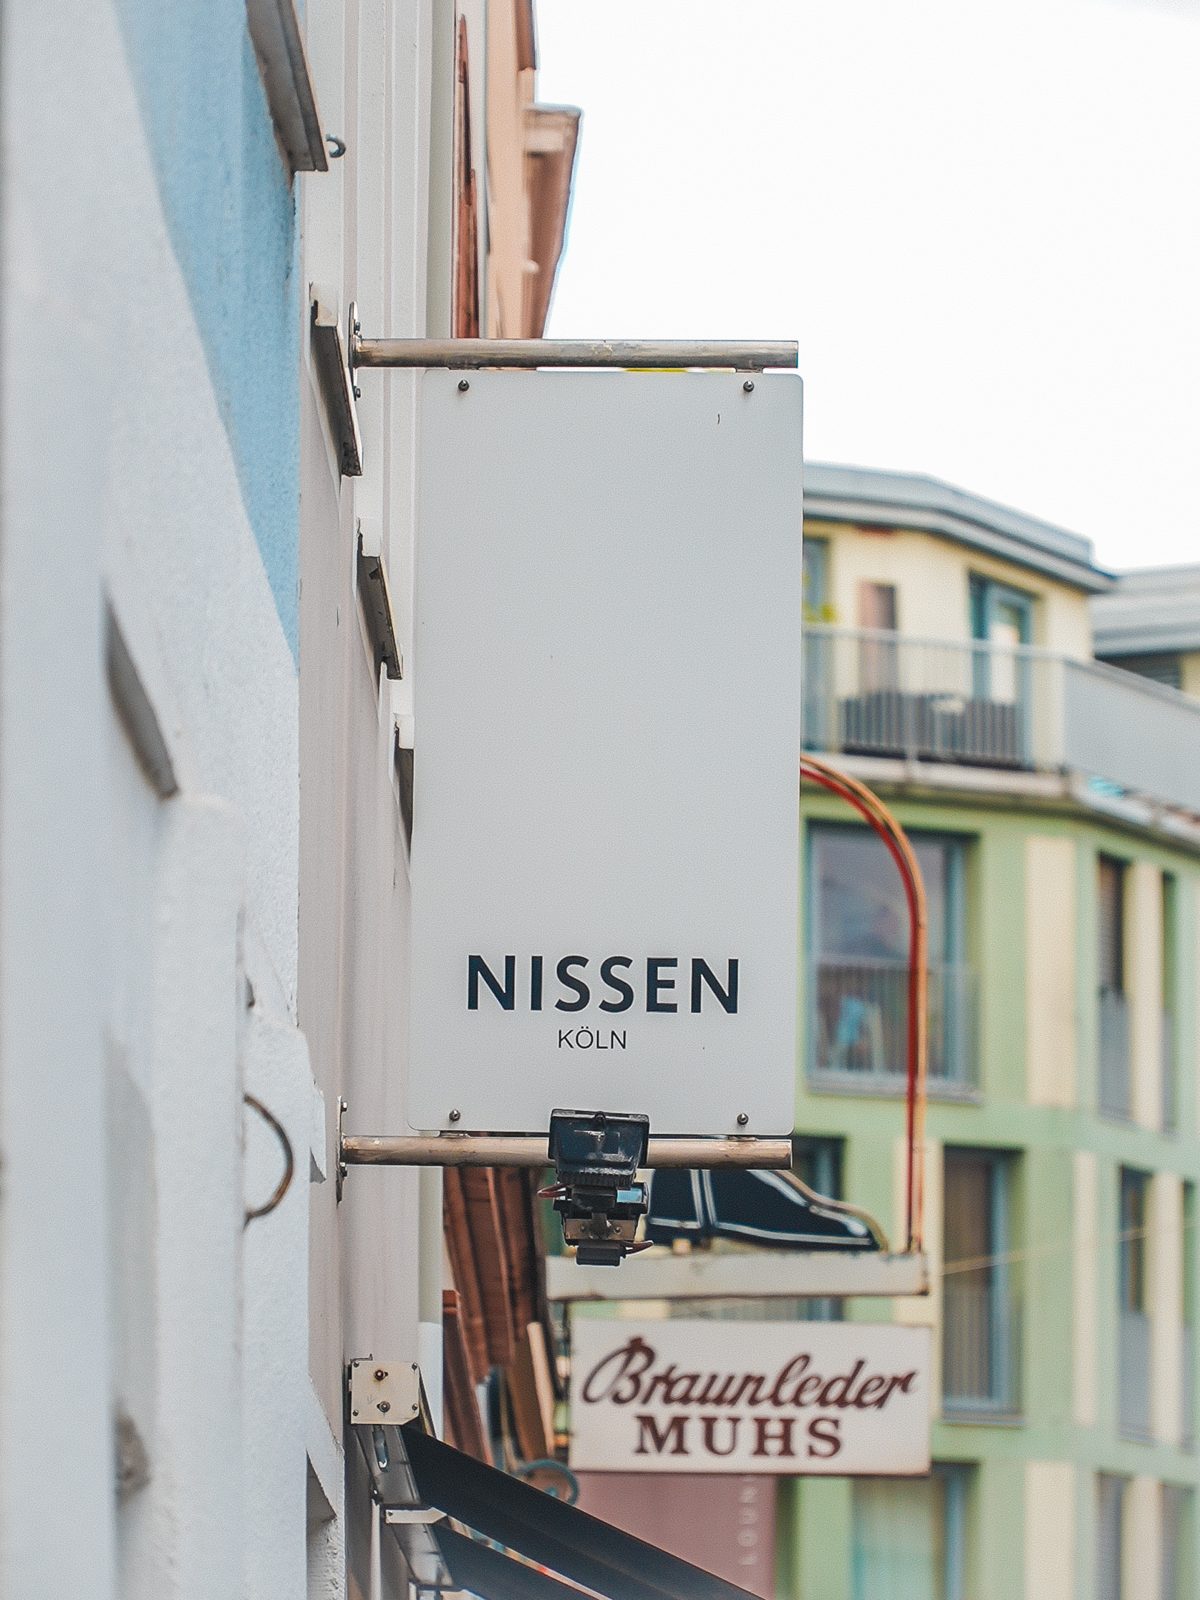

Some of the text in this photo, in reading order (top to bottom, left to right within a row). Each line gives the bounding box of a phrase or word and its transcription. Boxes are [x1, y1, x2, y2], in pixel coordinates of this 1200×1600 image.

[467, 955, 739, 1014] NISSEN
[558, 1026, 627, 1049] KÖLN
[582, 1337, 919, 1410] Braunleder
[634, 1415, 842, 1458] MUHS
